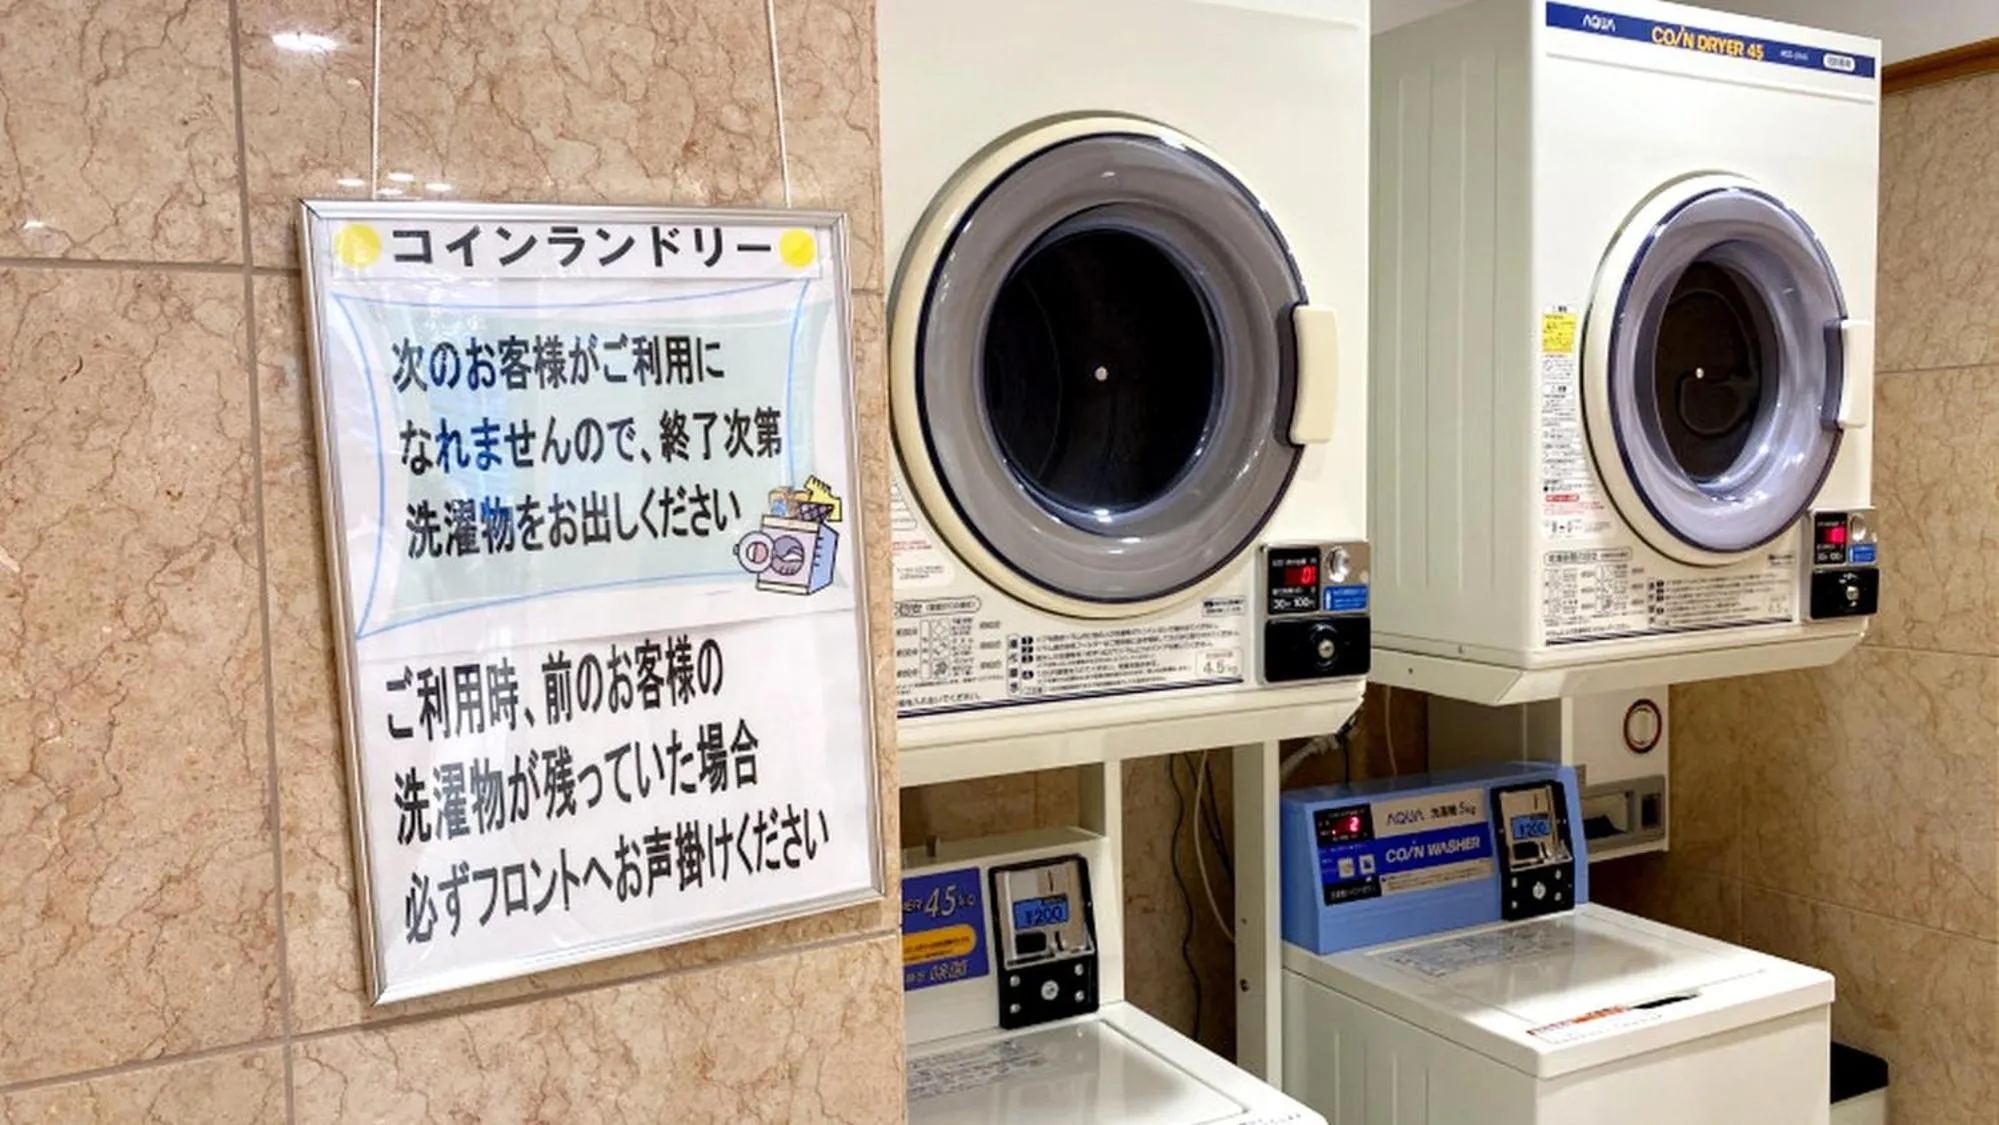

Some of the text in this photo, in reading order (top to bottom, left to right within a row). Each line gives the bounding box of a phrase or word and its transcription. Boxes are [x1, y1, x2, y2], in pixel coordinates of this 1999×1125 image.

[1583, 14, 1616, 32] AQUA
[1697, 35, 1744, 57] DRYER
[1747, 43, 1764, 61] 45
[392, 225, 773, 268] コインランドリー
[391, 335, 726, 391] 次のお客様がご利用に
[400, 407, 782, 475] なれませんので、終了次第
[406, 484, 742, 559] 洗濯物をお出しください
[386, 637, 724, 742] ご利用時、前のお客様の
[394, 717, 760, 845] 洗濯物が残っていた場合
[404, 803, 830, 944] 必ずフロントへお声掛けください
[1427, 836, 1480, 857] WASHER
